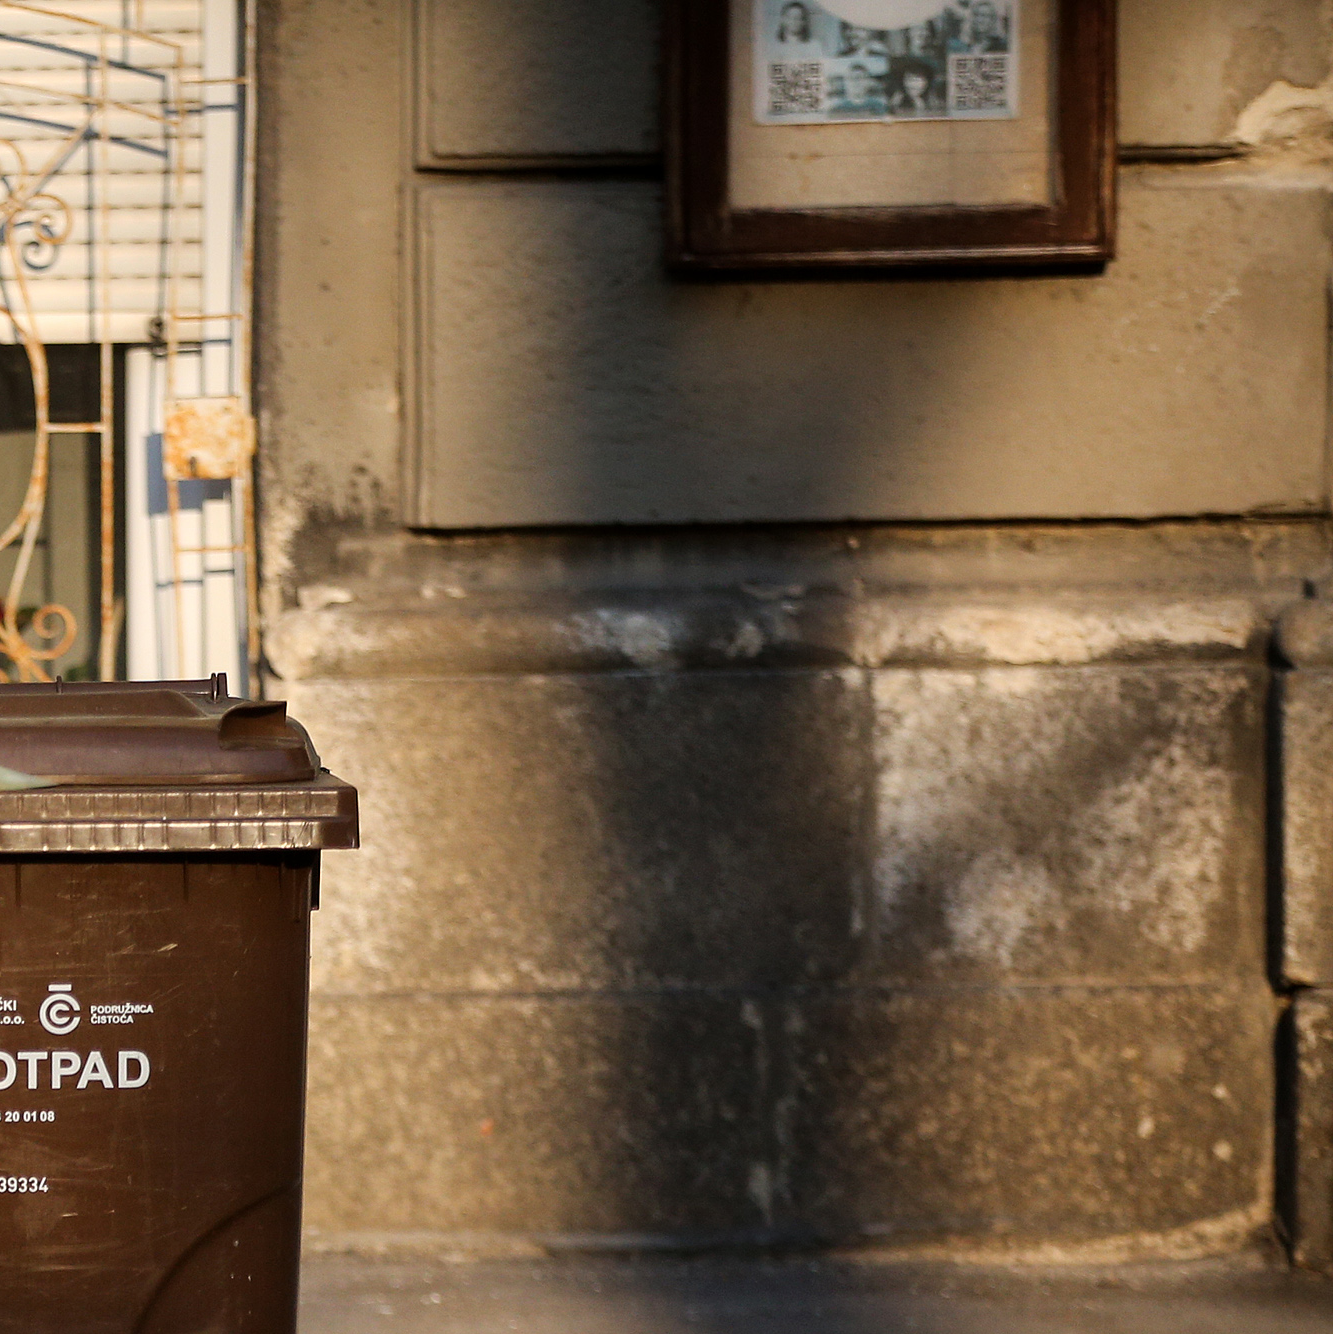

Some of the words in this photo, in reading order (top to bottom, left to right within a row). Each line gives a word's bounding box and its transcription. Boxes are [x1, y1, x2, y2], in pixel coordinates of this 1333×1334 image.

[90, 1002, 154, 1014] PODRUŽNICA
[90, 1013, 134, 1025] ČISTOĆA
[4, 1110, 20, 1123] 20
[23, 1110, 37, 1123] 01
[39, 1110, 55, 1122] 08
